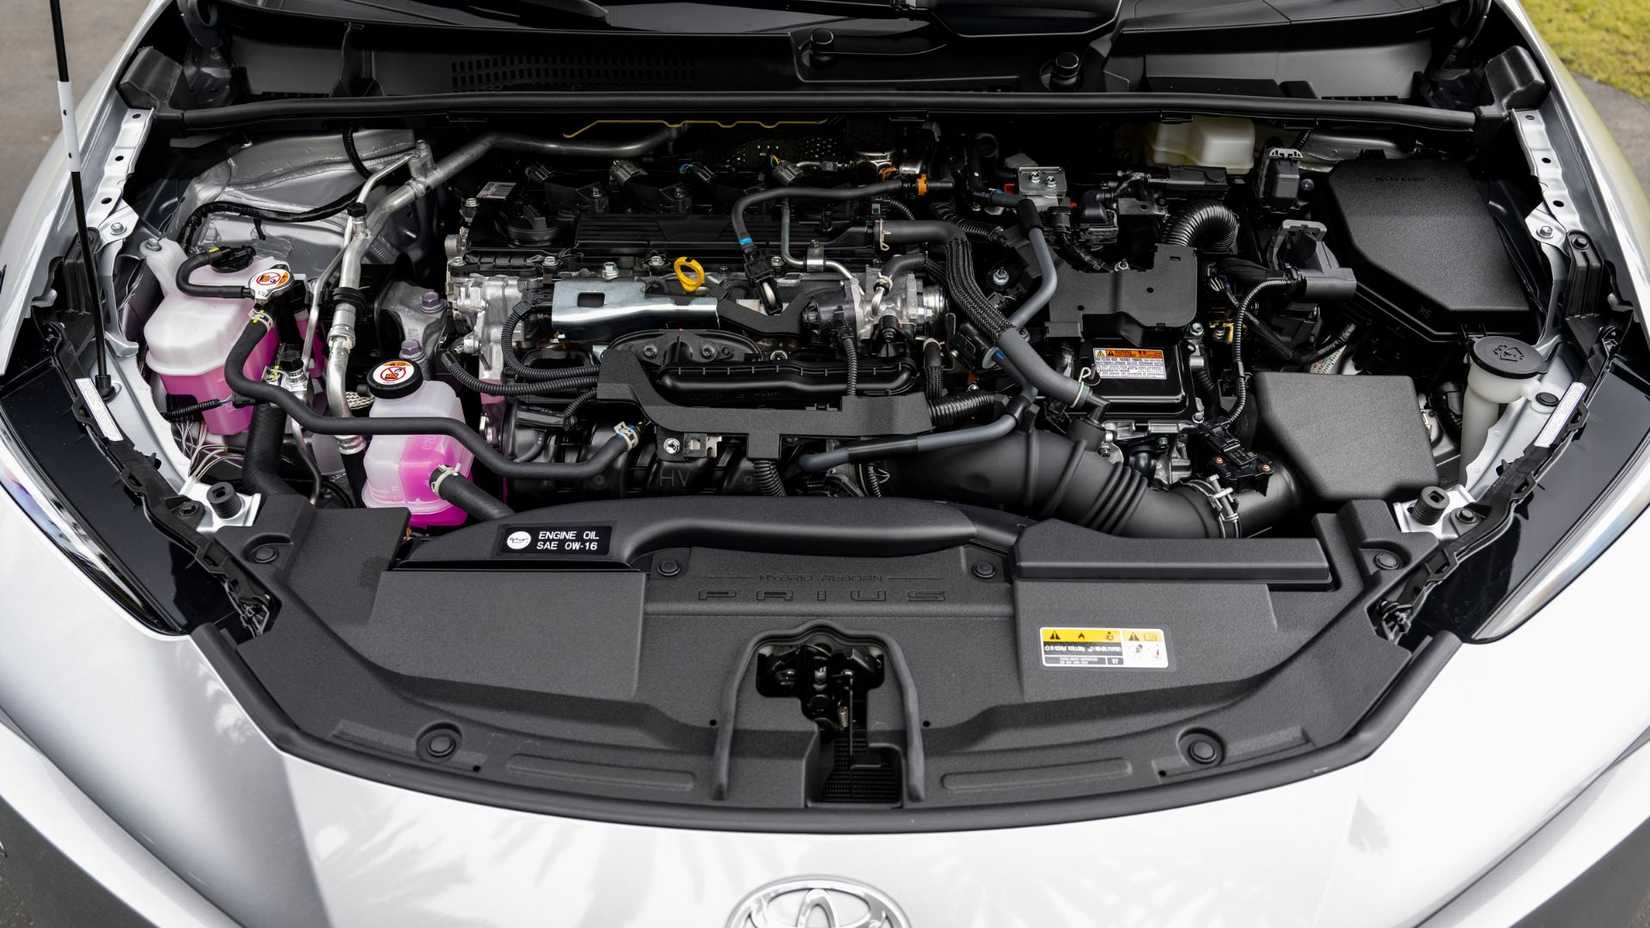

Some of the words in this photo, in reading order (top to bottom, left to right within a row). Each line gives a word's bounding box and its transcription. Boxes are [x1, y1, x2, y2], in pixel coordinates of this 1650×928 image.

[538, 531, 577, 540] ENGINE
[582, 531, 600, 540] OIL
[536, 541, 559, 550] SAE
[564, 541, 598, 551] 0W-16
[698, 590, 947, 602] PRIUS
